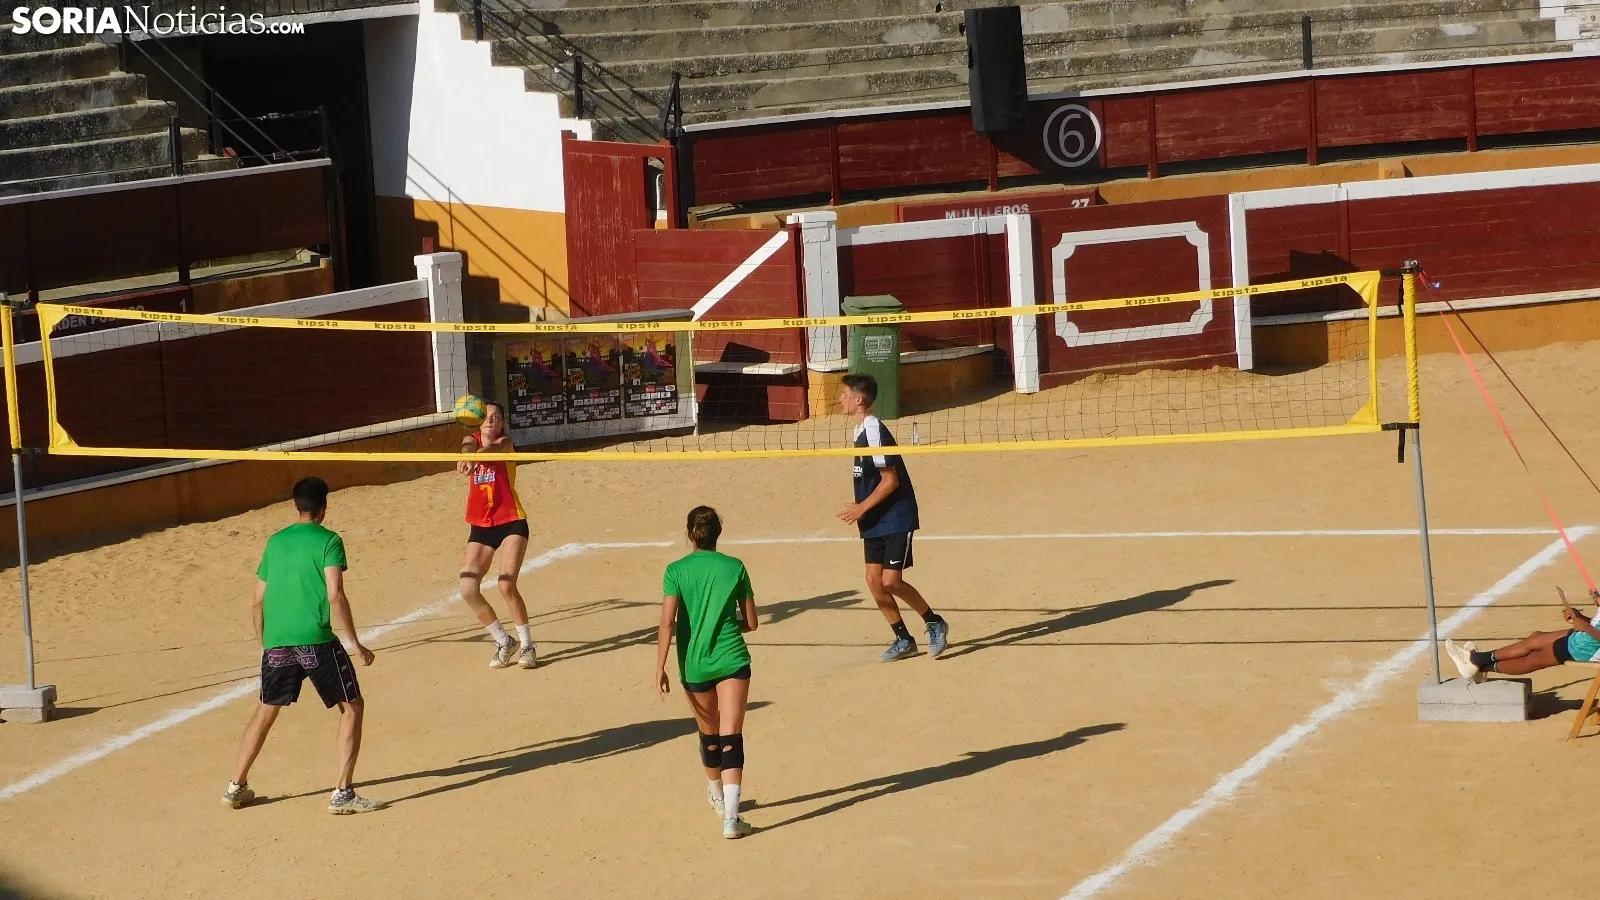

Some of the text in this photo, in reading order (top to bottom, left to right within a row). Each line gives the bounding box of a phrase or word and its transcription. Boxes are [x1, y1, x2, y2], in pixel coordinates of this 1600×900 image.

[1058, 113, 1085, 158] 6
[1071, 197, 1090, 209] 27
[479, 484, 494, 508] 7
